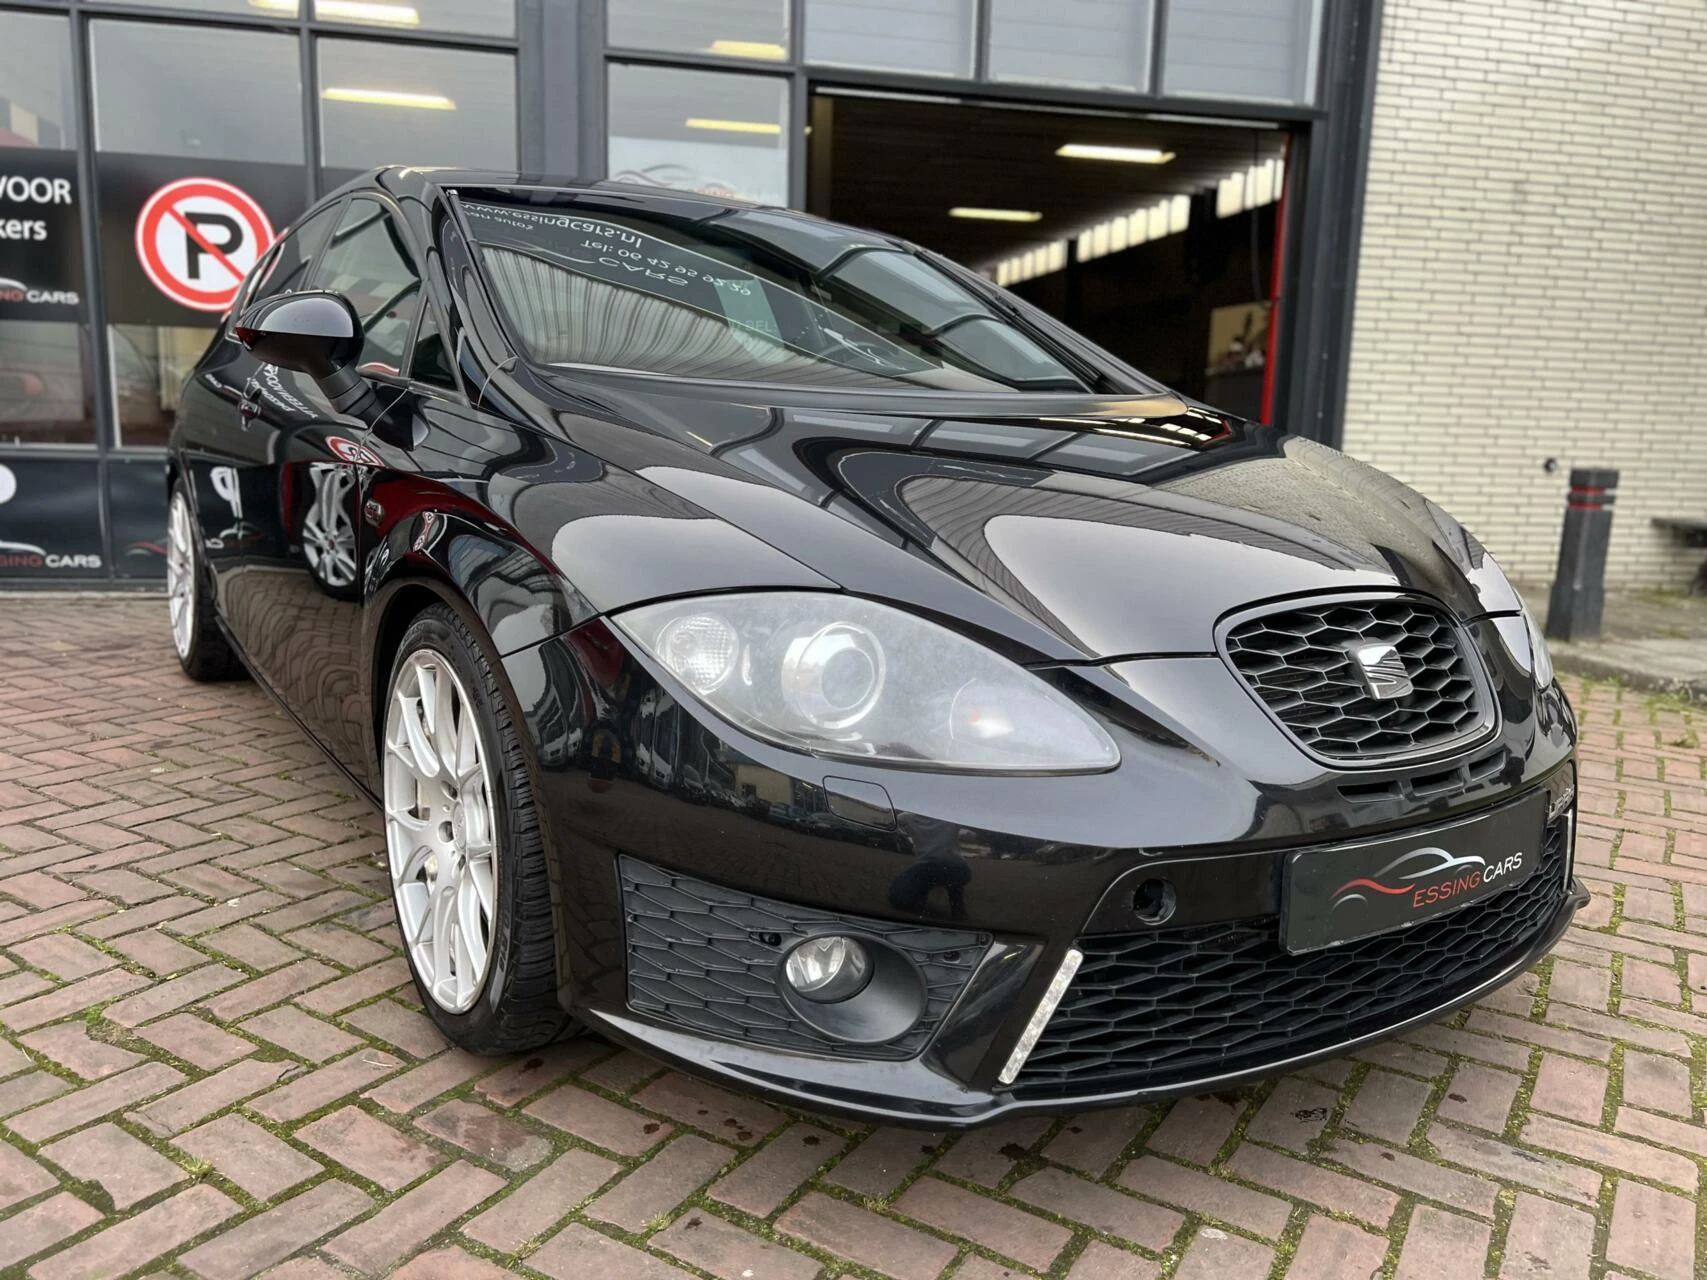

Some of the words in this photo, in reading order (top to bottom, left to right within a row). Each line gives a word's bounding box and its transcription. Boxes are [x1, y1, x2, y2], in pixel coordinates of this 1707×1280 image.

[26, 289, 80, 305] CARS
[45, 553, 103, 569] CARS
[1413, 871, 1482, 908] ESSING
[1483, 852, 1523, 883] CARS
